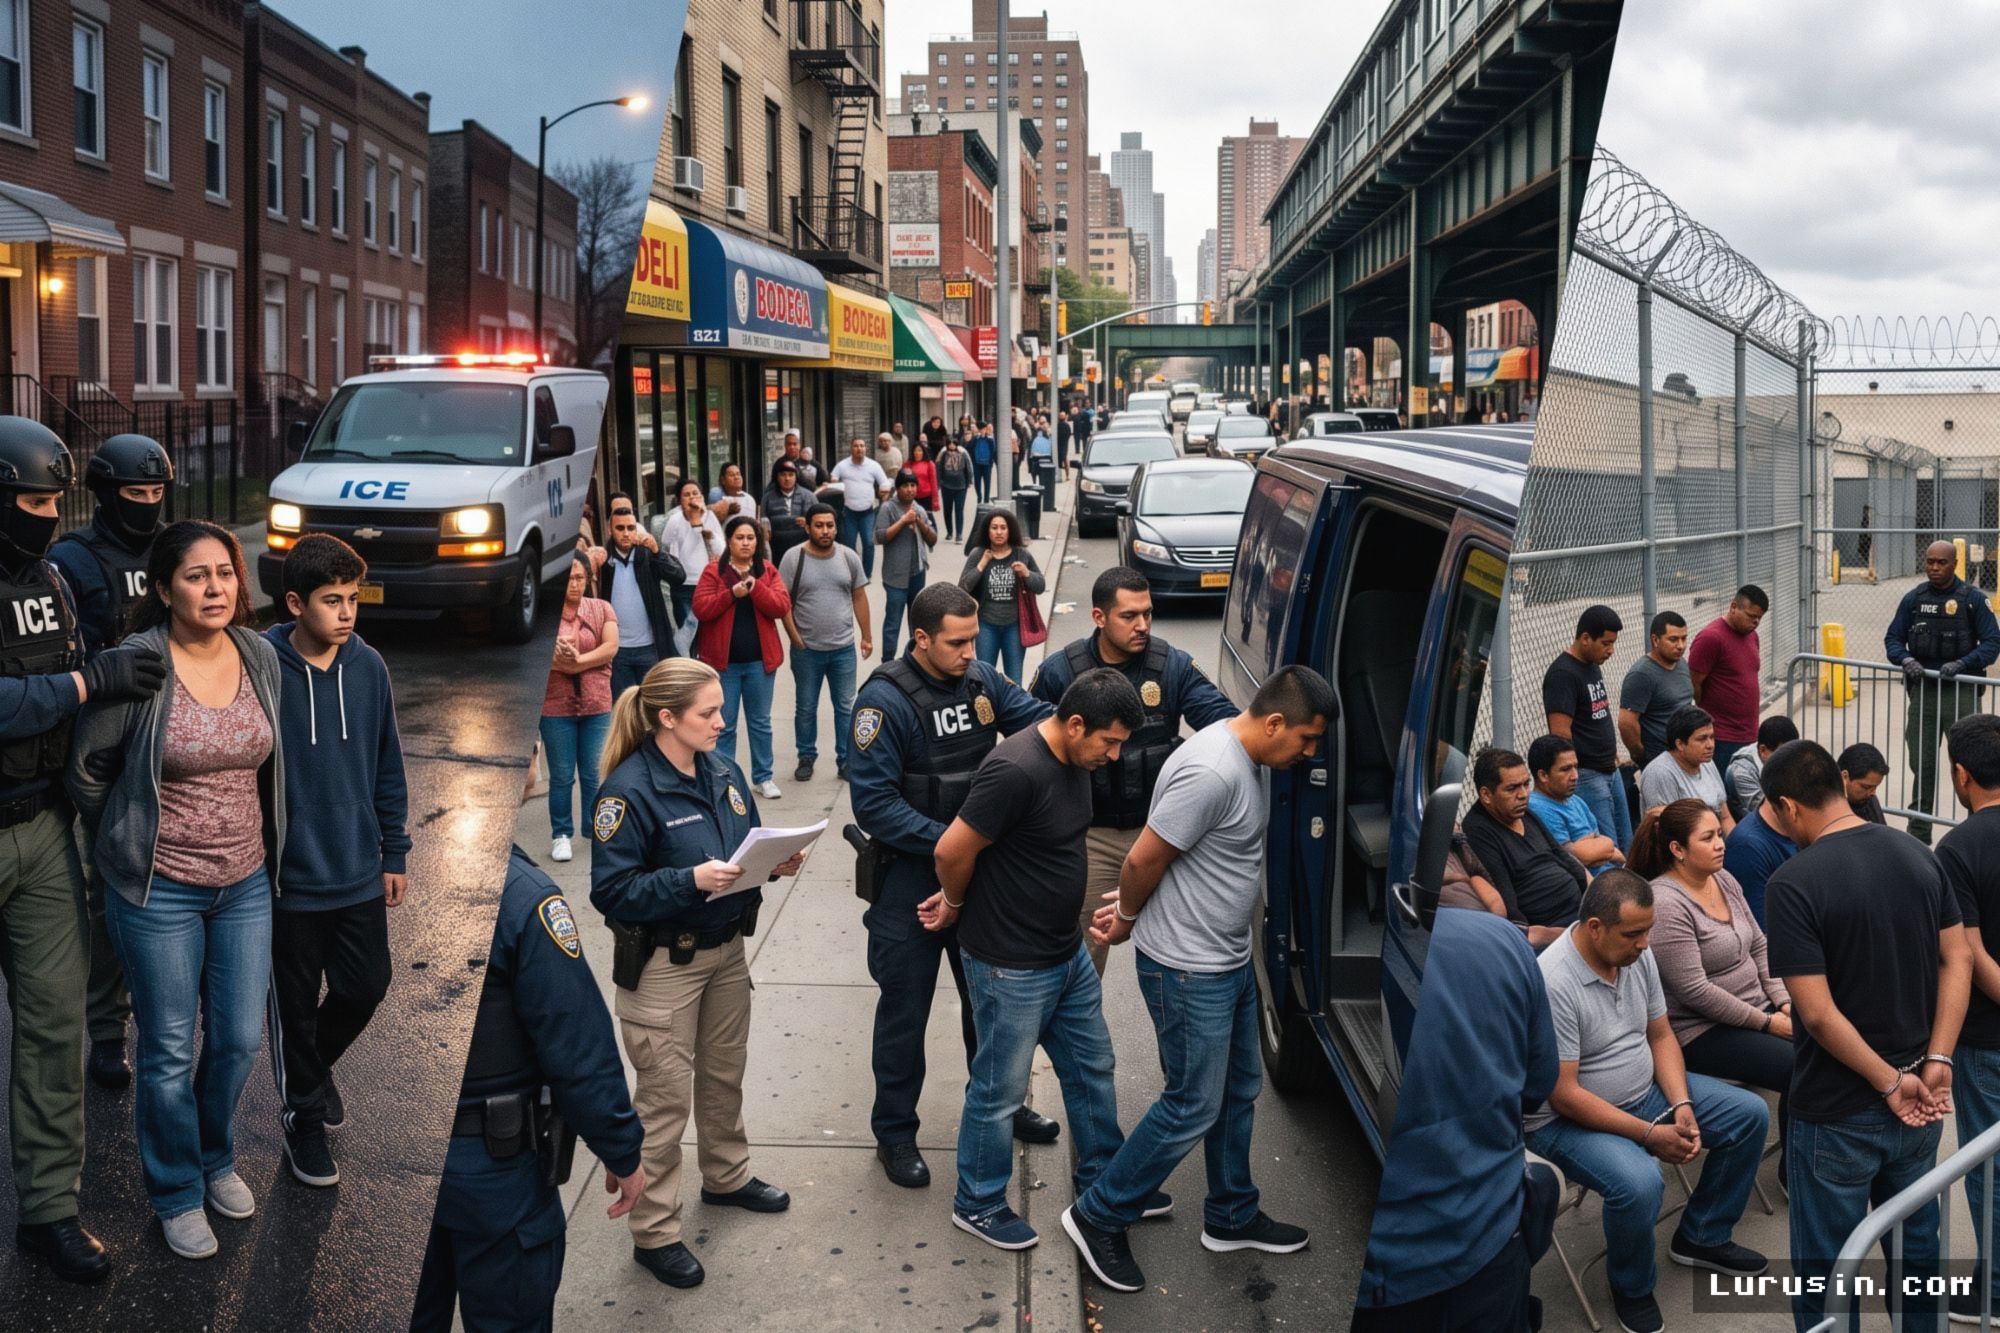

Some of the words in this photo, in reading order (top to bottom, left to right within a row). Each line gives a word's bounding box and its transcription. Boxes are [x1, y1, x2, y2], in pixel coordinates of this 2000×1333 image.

[636, 235, 679, 290] DELI
[755, 277, 813, 328] BODEGA
[693, 329, 721, 342] 821
[843, 304, 887, 340] BODEGA
[339, 480, 411, 501] ICE
[12, 596, 60, 636] ICE
[932, 704, 972, 737] ICE
